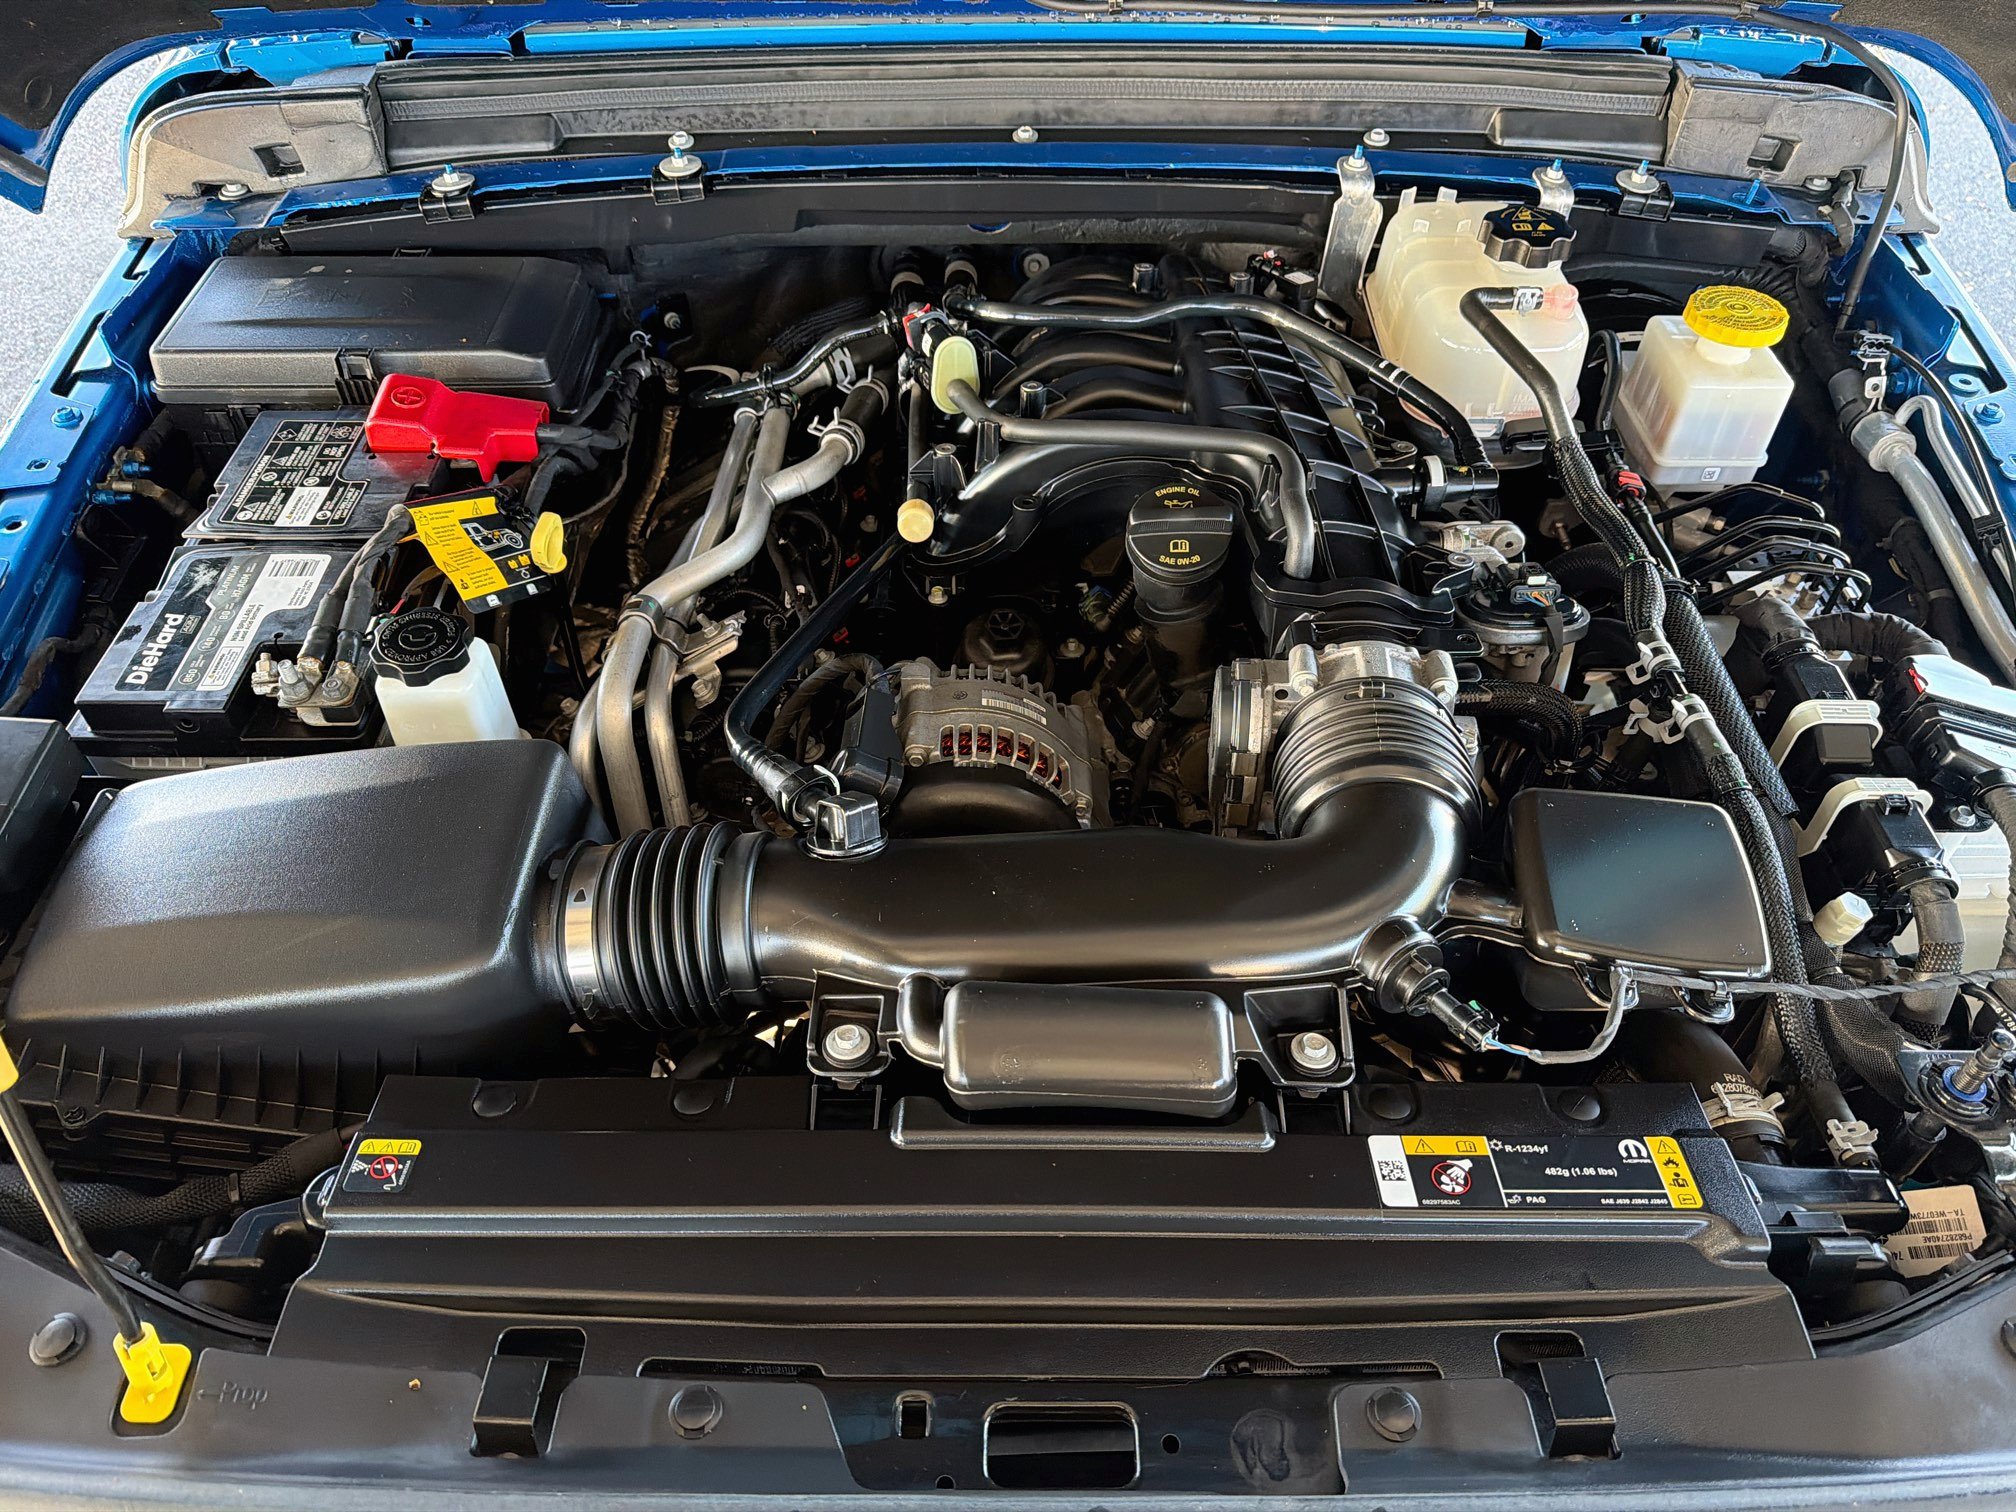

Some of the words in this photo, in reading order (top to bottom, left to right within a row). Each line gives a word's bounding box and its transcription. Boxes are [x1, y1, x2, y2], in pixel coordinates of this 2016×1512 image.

[236, 455, 271, 504] DANGER/POISON
[1155, 486, 1186, 498] ENGINE
[1187, 487, 1201, 497] OIL
[1159, 555, 1176, 565] SAE
[1177, 554, 1201, 565] 0W-20
[218, 565, 240, 596] PLATINUM
[125, 613, 184, 685] DieHard
[200, 636, 216, 650] 140
[384, 647, 428, 662] APPROVED
[182, 668, 199, 683] 850
[1723, 1073, 1746, 1083] RAD
[1505, 1144, 1549, 1155] R-1234yf
[1545, 1167, 1570, 1177] 482g
[1571, 1167, 1596, 1177] (1.06
[1598, 1167, 1618, 1177] lbs)
[1526, 1196, 1547, 1204] PAG
[1923, 1233, 1973, 1244] P68282740AE
[220, 1382, 268, 1410] Prop
